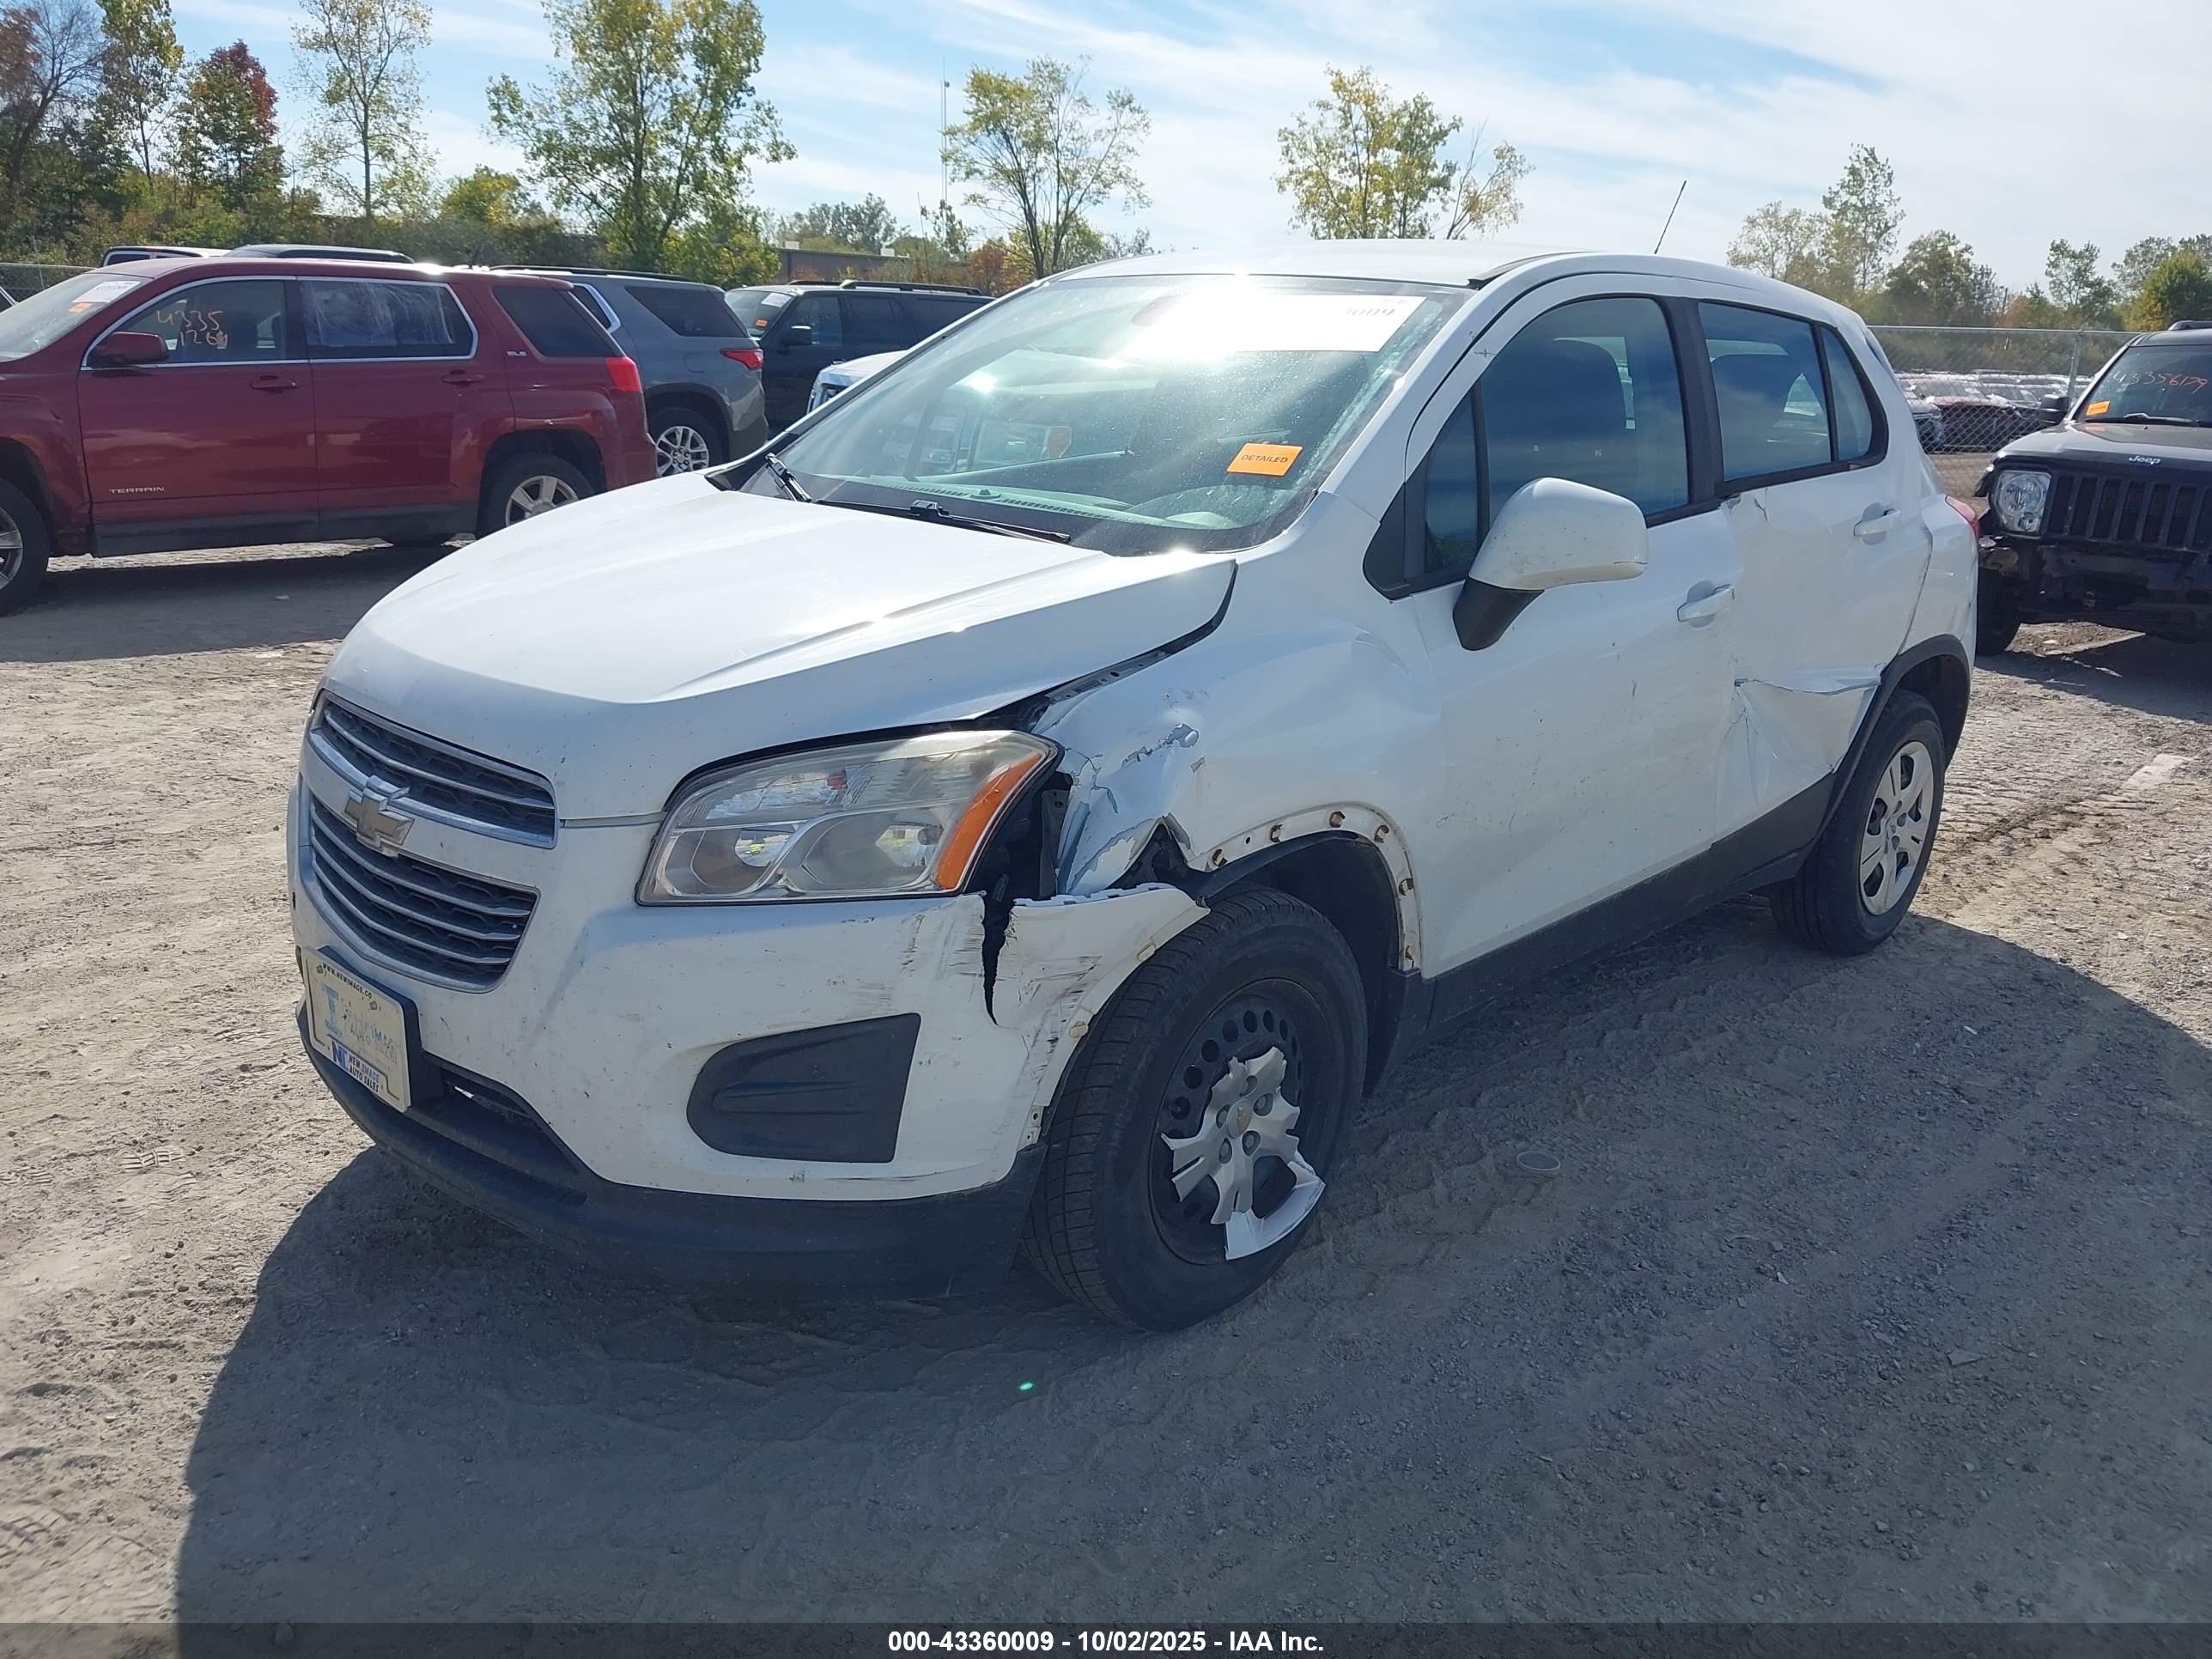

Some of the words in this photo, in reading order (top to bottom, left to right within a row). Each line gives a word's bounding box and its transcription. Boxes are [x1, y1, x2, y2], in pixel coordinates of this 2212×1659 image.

[155, 309, 224, 331] 4335
[1240, 453, 1289, 465] DETAILED
[2128, 455, 2162, 465] Jeep
[109, 486, 165, 495] TERRAIN
[349, 1054, 361, 1068] NEW
[362, 1064, 380, 1084] IMAGE
[349, 1064, 363, 1081] AUTO
[363, 1075, 380, 1093] SALES
